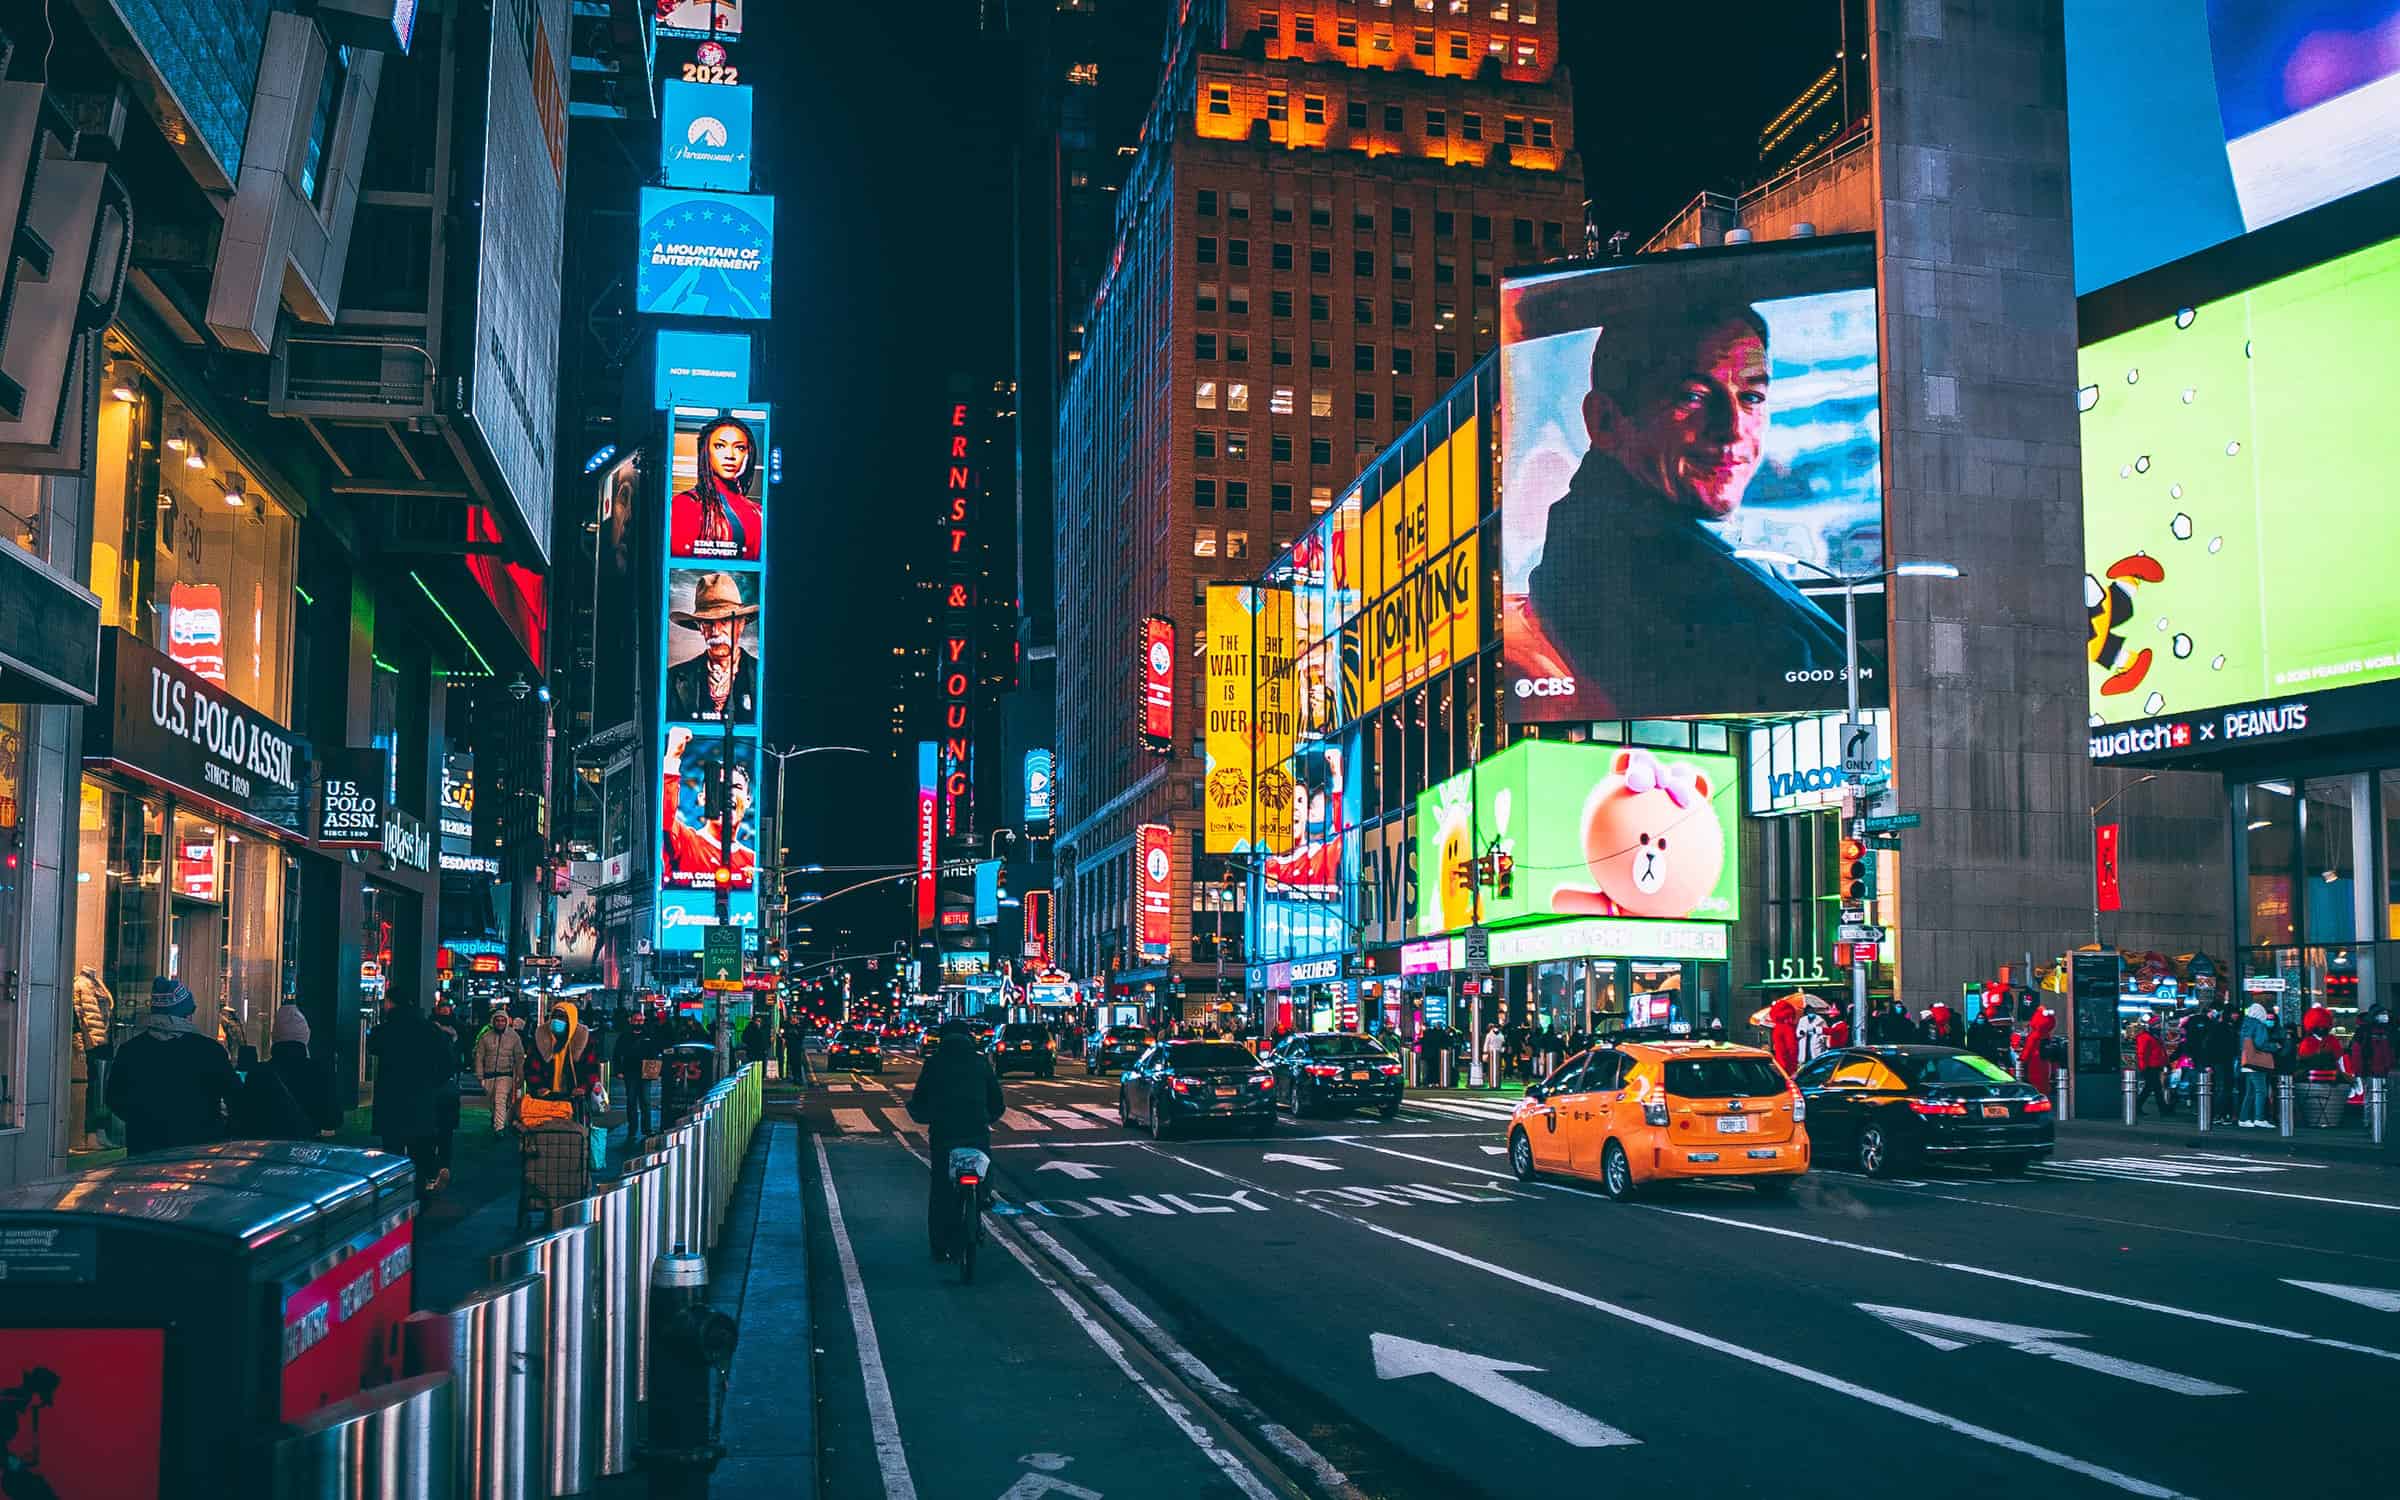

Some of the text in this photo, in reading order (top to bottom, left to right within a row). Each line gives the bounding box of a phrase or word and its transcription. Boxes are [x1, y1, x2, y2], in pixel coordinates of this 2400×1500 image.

[682, 63, 738, 85] 2022
[652, 243, 760, 260] A MOUNTAIN OF
[651, 254, 761, 271] ENTERTAINMENT
[670, 367, 737, 379] NOW STREAMING
[949, 403, 968, 553] ERNST
[1394, 503, 1425, 561] THE
[693, 548, 738, 556] DISCOVERY
[948, 584, 968, 608] &
[1367, 583, 1411, 682] LION
[1415, 551, 1469, 653] KING
[1220, 635, 1239, 651] THE
[1211, 653, 1248, 677] WAIT
[1785, 667, 1873, 683] GOOD SM
[2312, 659, 2363, 679] PEANUTS
[1223, 684, 1235, 701] IS
[1533, 678, 1576, 697] CBS
[945, 638, 968, 797] YOUNG
[1210, 709, 1248, 733] OVER
[2224, 703, 2309, 739] PEANUTS
[151, 666, 296, 791] U.S. POLO ASSN.
[1846, 760, 1873, 771] ONLY
[204, 761, 250, 798] SINCE 1890
[326, 780, 359, 797] U.S.
[324, 796, 376, 813] POLO
[323, 812, 380, 829] ASSN.
[414, 822, 431, 873] hut
[943, 912, 969, 925] NETFLIX
[1467, 945, 1488, 959] 25
[1291, 959, 1337, 980] SKECHERS
[1767, 957, 1824, 982] 1515
[1025, 1189, 1271, 1219] ONLY
